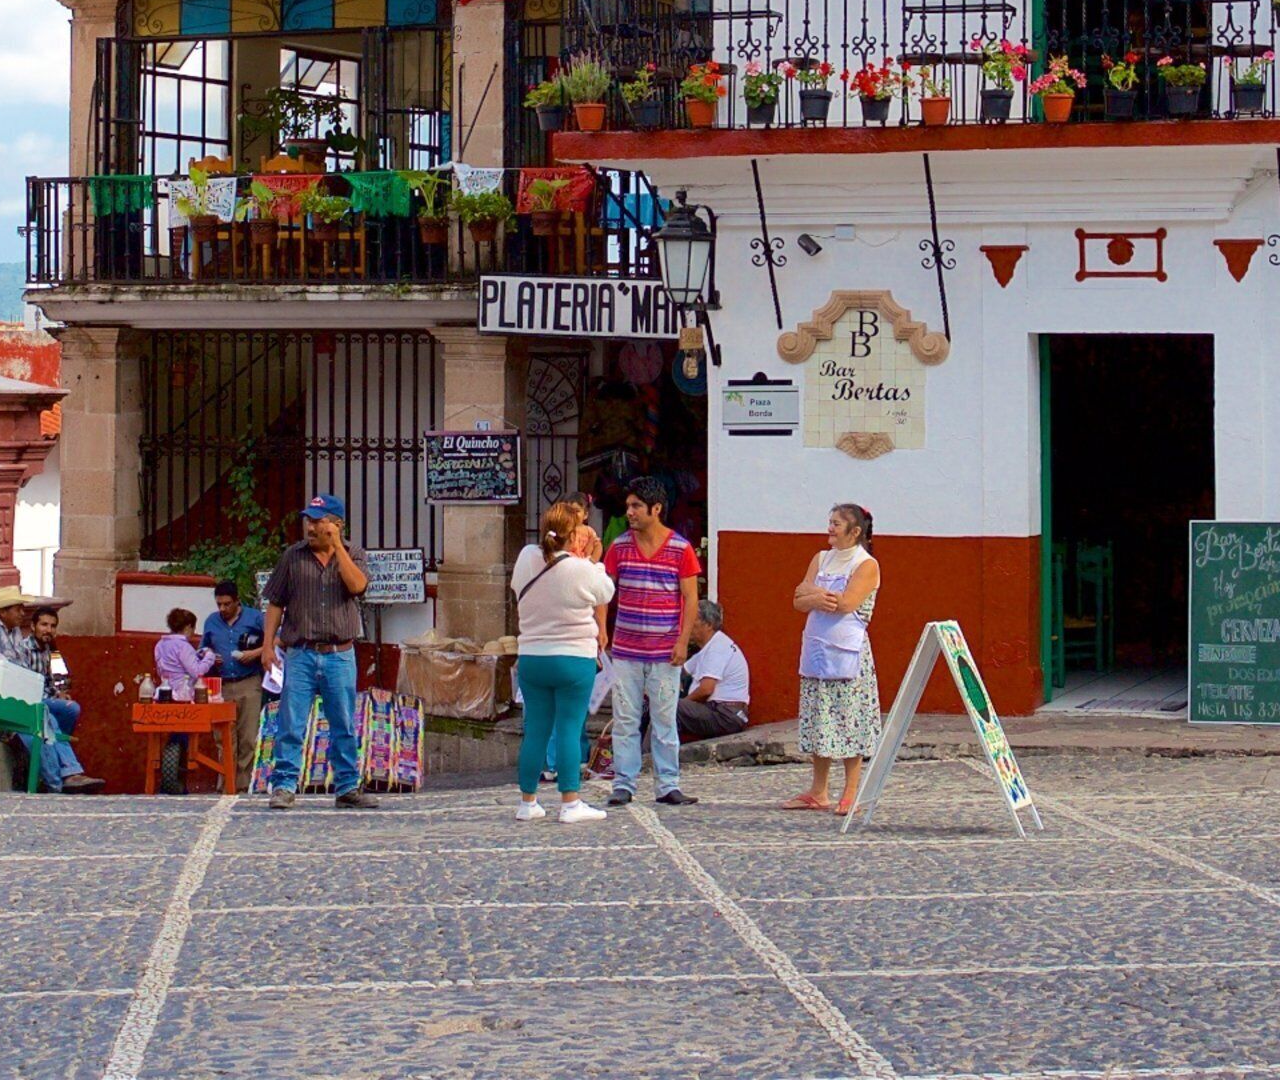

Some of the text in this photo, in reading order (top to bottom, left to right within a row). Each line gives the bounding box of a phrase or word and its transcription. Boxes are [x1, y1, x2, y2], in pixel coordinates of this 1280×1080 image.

[481, 279, 615, 333] PLATERIA
[819, 359, 856, 378] Bar
[831, 378, 911, 402] Bertas
[749, 398, 772, 406] Plaza
[748, 409, 773, 417] Borda
[443, 435, 500, 453] El Quincho
